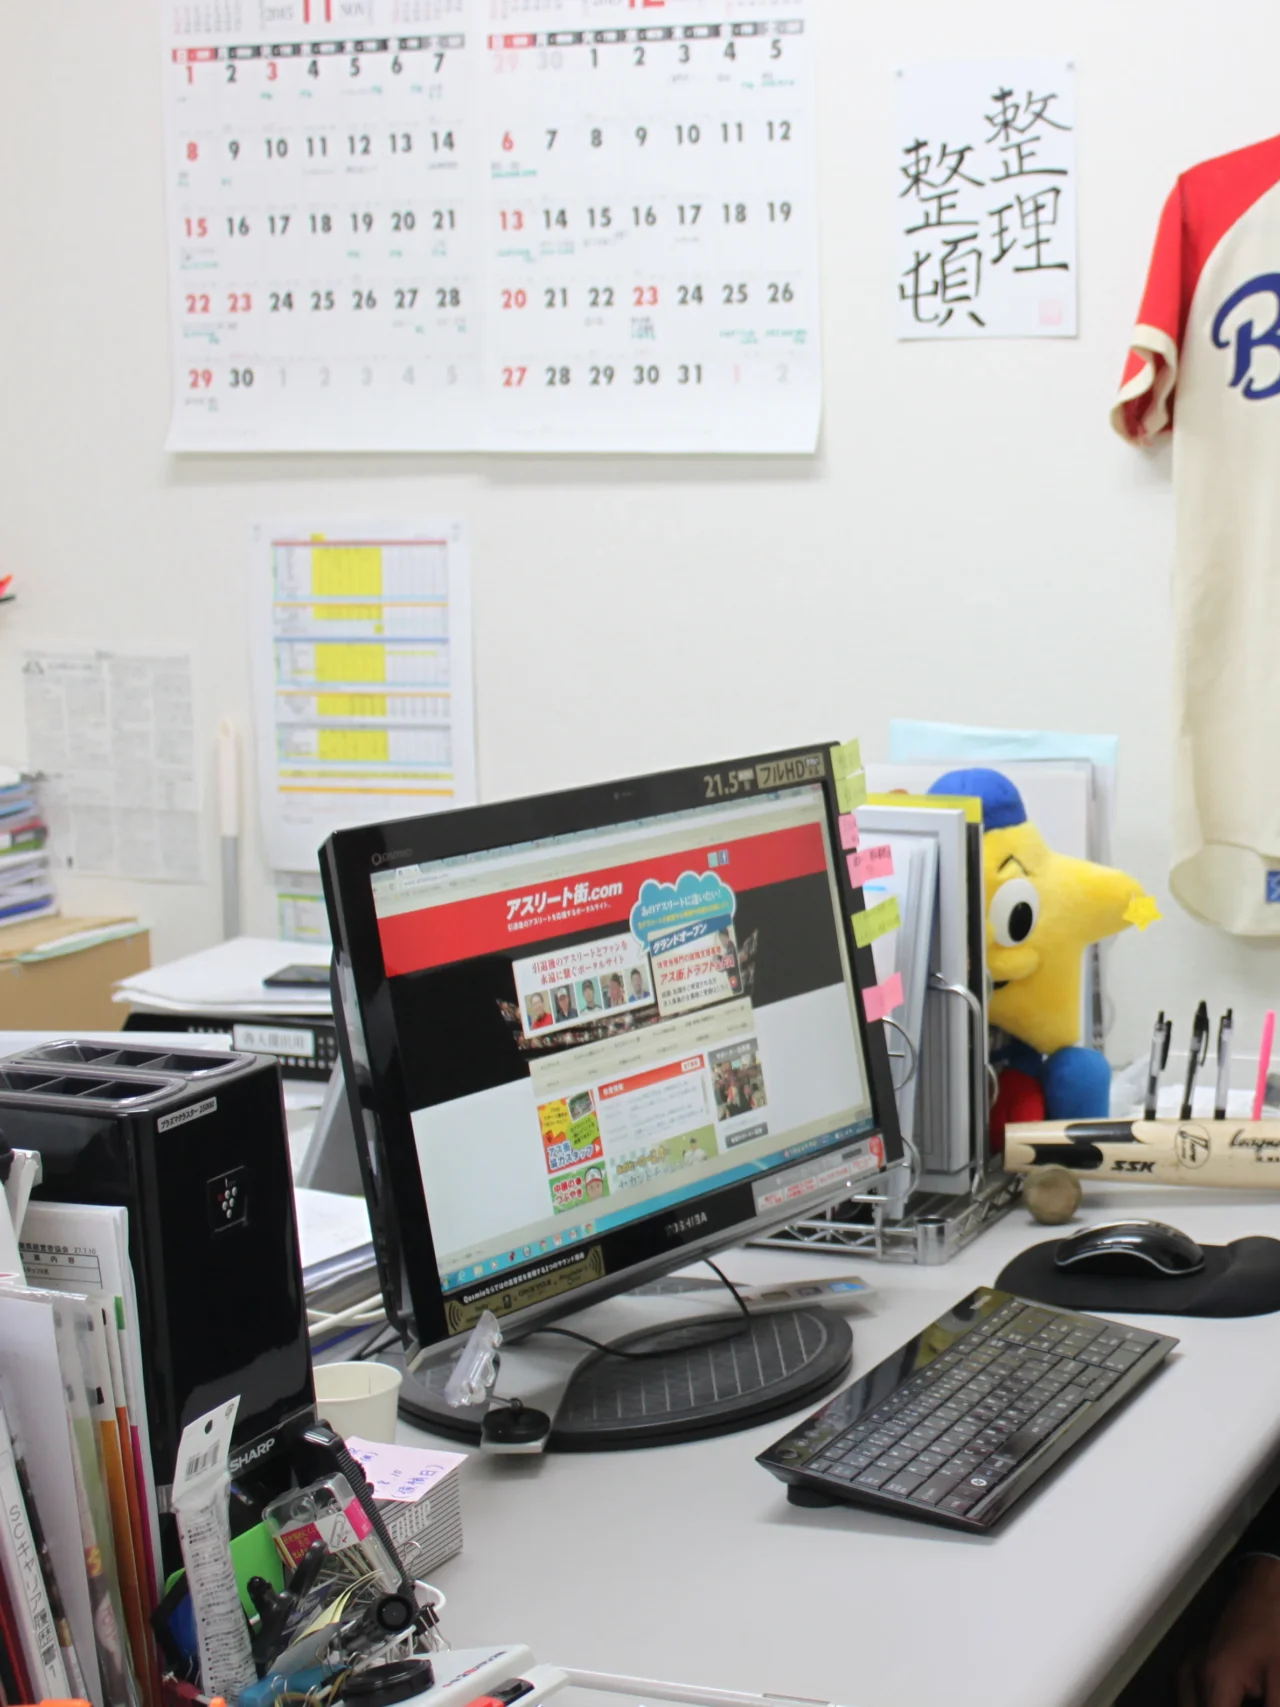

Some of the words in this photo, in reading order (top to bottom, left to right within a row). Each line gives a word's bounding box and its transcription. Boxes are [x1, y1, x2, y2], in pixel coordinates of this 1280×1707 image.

[185, 64, 194, 85] 1
[225, 63, 237, 83] 2
[267, 61, 278, 82] 3
[308, 59, 319, 78] 4
[350, 56, 361, 77] 5
[391, 54, 403, 75] 6
[434, 51, 445, 73] 7
[590, 47, 598, 69] 1
[633, 45, 645, 66] 2
[679, 43, 691, 64] 3
[723, 40, 736, 61] 4
[770, 38, 782, 60] 5
[186, 141, 199, 162] 8
[228, 139, 240, 160] 9
[265, 137, 288, 159] 10
[306, 136, 327, 157] 11
[348, 134, 371, 155] 12
[389, 132, 412, 153] 13
[431, 131, 455, 151] 14
[501, 131, 514, 152] 6
[546, 129, 558, 150] 7
[590, 127, 603, 148] 8
[635, 125, 648, 146] 9
[675, 123, 701, 145] 10
[720, 121, 743, 143] 11
[766, 120, 791, 141] 12
[984, 86, 1073, 273] 整理
[184, 217, 208, 238] 15
[227, 216, 250, 236] 16
[268, 214, 291, 235] 17
[309, 213, 333, 234] 18
[350, 212, 374, 232] 19
[391, 210, 416, 232] 20
[432, 209, 455, 230] 21
[500, 210, 524, 231] 13
[544, 208, 568, 229] 14
[587, 206, 612, 228] 15
[632, 205, 657, 226] 16
[677, 203, 702, 225] 17
[723, 202, 747, 224] 18
[768, 201, 792, 222] 19
[899, 138, 986, 327] 整頓
[185, 293, 211, 314] 22
[227, 292, 252, 313] 23
[269, 291, 294, 311] 24
[310, 289, 335, 311] 25
[352, 289, 377, 310] 26
[394, 288, 419, 309] 27
[436, 287, 461, 308] 28
[501, 288, 527, 310] 20
[544, 287, 568, 308] 21
[588, 286, 614, 307] 22
[633, 285, 659, 307] 23
[678, 284, 703, 305] 24
[723, 283, 748, 304] 25
[768, 282, 794, 303] 26
[189, 368, 213, 389] 29
[230, 367, 255, 388] 30
[503, 366, 527, 387] 27
[546, 366, 571, 386] 28
[589, 365, 615, 386] 29
[634, 364, 660, 385] 30
[678, 363, 702, 384] 31
[703, 770, 739, 798] 21.5
[758, 761, 806, 785] フルHD
[507, 881, 623, 921] アスリート街.com
[652, 923, 708, 952] グランドオープン
[160, 1108, 199, 1130] プラズマクラスター
[1110, 1160, 1156, 1174] SSK
[229, 1438, 276, 1473] SHARP
